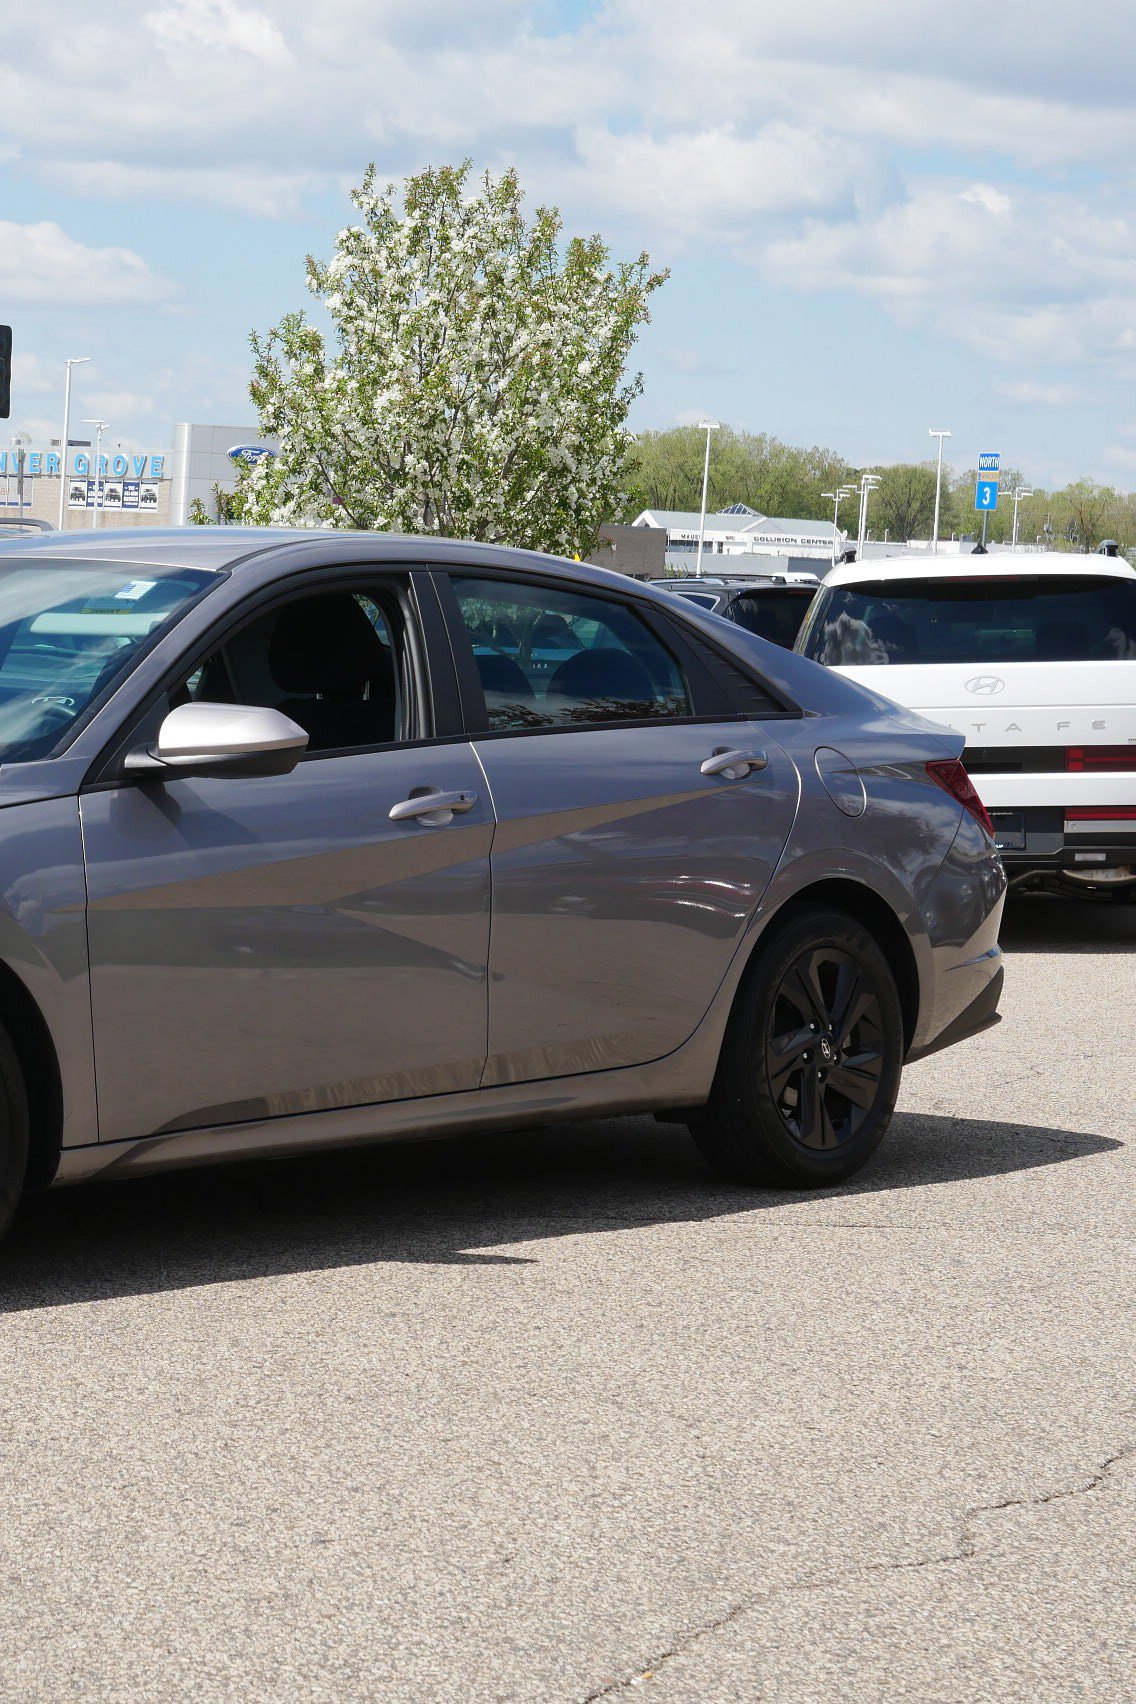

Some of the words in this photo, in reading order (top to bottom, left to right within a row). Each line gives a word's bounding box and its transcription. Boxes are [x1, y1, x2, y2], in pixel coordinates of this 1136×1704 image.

[74, 453, 164, 478] GROVE
[979, 456, 999, 468] NORTH
[982, 487, 990, 505] 3
[753, 536, 797, 544] COLLISION
[1056, 719, 1106, 731] FE
